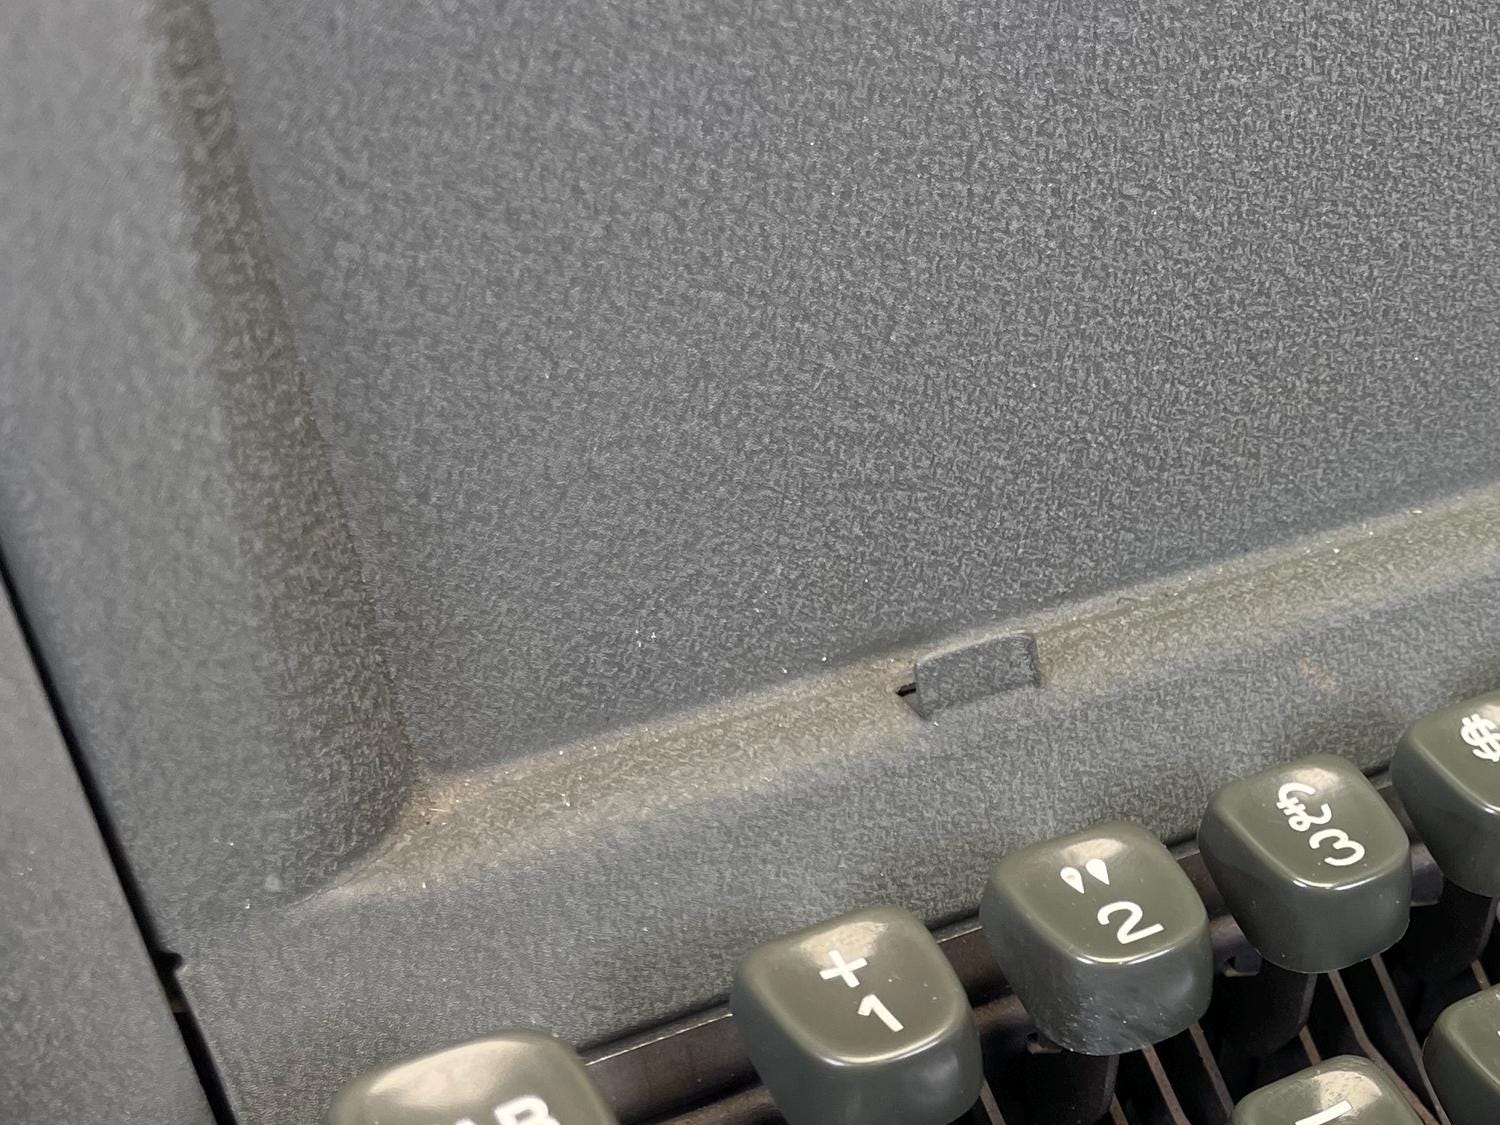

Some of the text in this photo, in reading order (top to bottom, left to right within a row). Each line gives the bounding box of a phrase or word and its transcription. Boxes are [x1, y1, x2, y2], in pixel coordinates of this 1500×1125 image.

[1310, 829, 1364, 865] 3
[1098, 902, 1163, 943] 2
[819, 950, 868, 989] +
[858, 995, 903, 1031] 1
